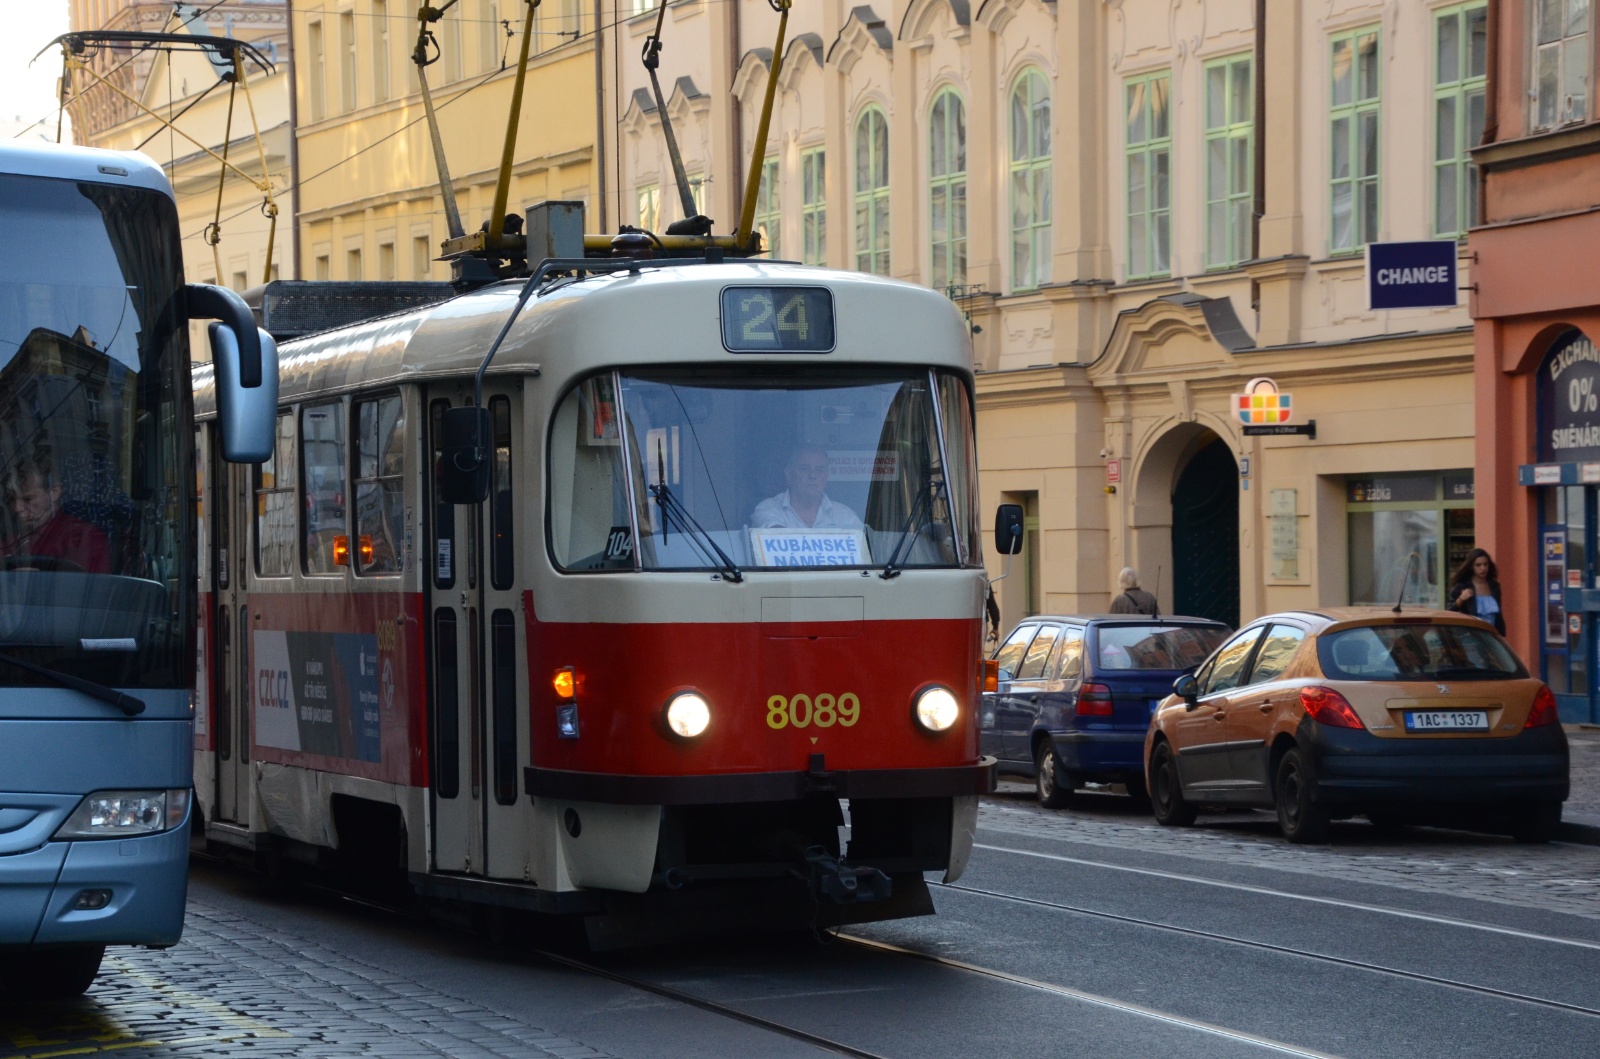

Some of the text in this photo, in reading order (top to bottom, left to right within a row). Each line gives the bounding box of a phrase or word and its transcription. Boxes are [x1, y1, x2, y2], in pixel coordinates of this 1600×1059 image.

[1377, 266, 1449, 285] CHANGE
[741, 294, 808, 340] 24
[1550, 339, 1600, 381] EXCHAN
[1569, 377, 1597, 412] 0%
[1552, 422, 1600, 449] SMĚNÁR
[1366, 484, 1391, 500] žabka
[608, 531, 633, 556] 104
[765, 536, 857, 552] KUBÁNSKÉ
[774, 553, 856, 566] NÁMĚSTÍ
[378, 620, 395, 651] 8089
[766, 692, 860, 729] 8089
[1417, 713, 1481, 727] 1AC 1337
